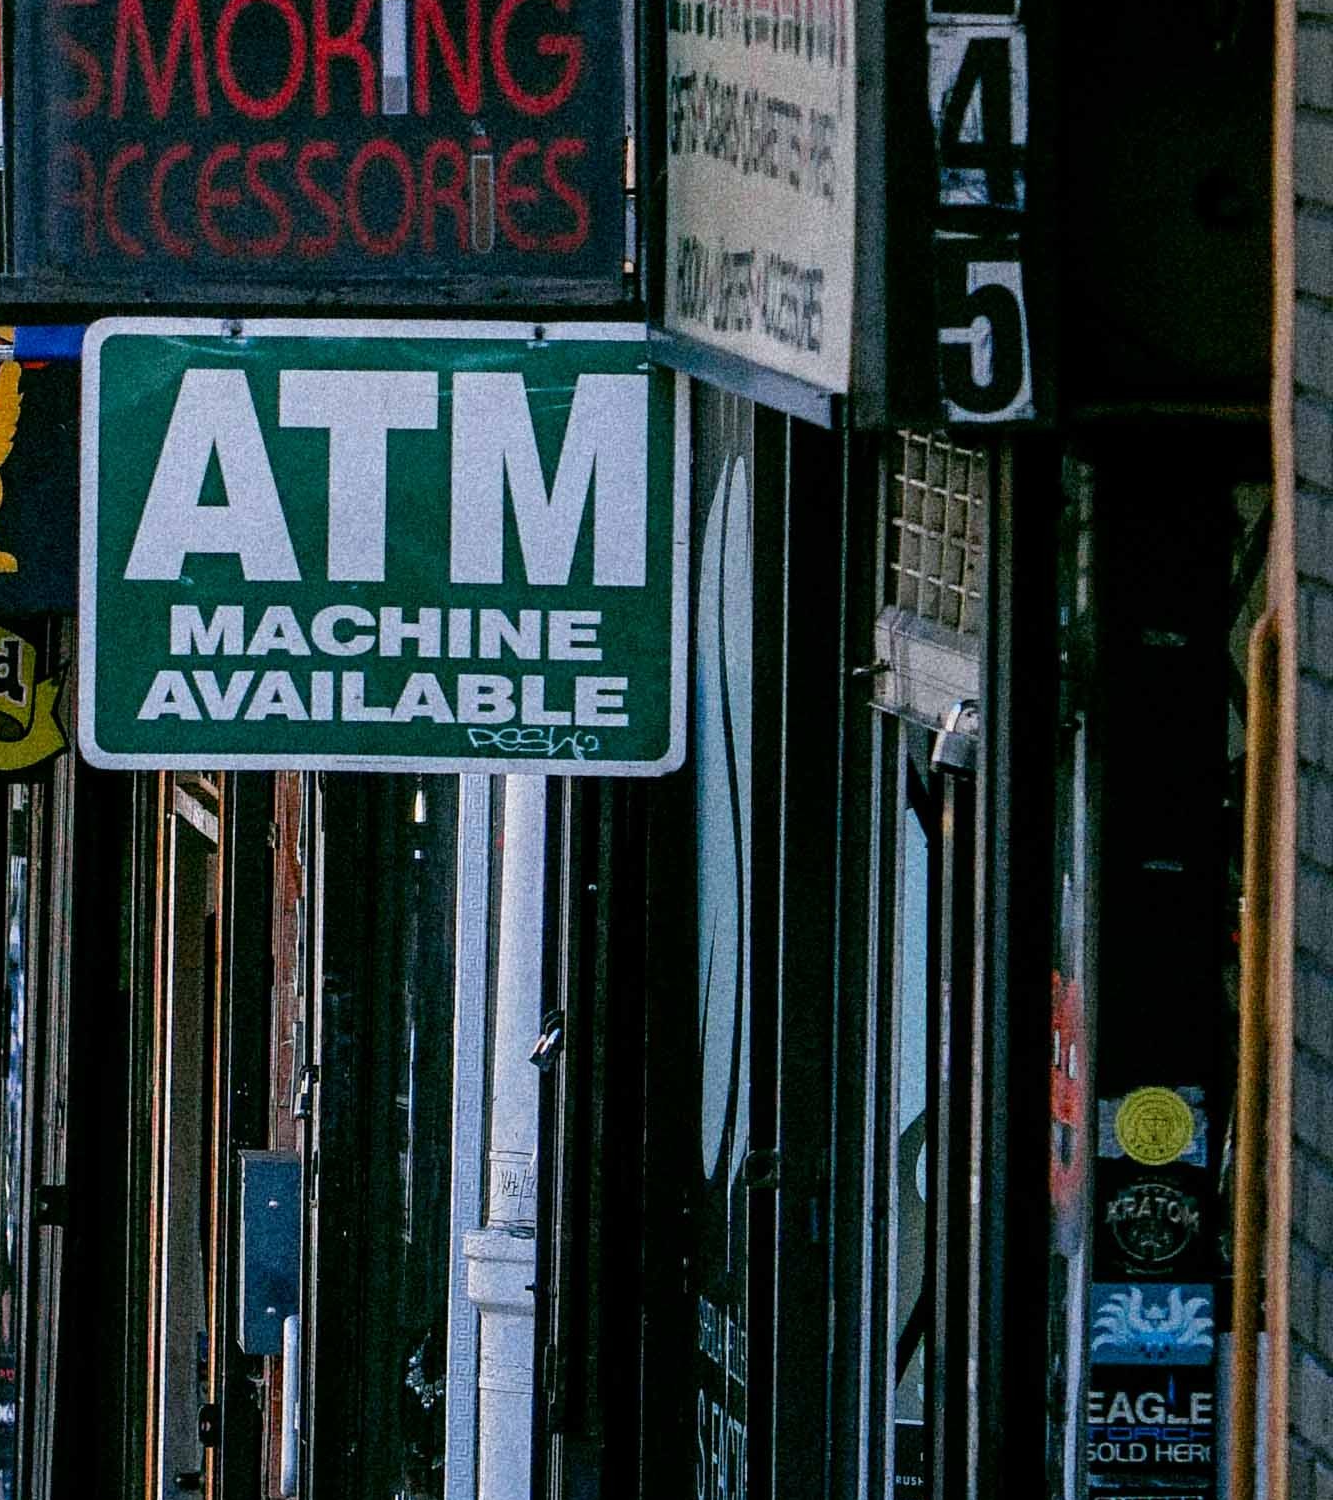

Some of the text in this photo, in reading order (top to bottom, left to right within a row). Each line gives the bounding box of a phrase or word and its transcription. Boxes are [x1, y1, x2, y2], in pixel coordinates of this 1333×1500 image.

[52, 138, 588, 256] ACCESSORIES
[123, 368, 648, 586] ATM
[170, 605, 602, 660] MACHINE
[137, 670, 629, 727] AVAILABLE
